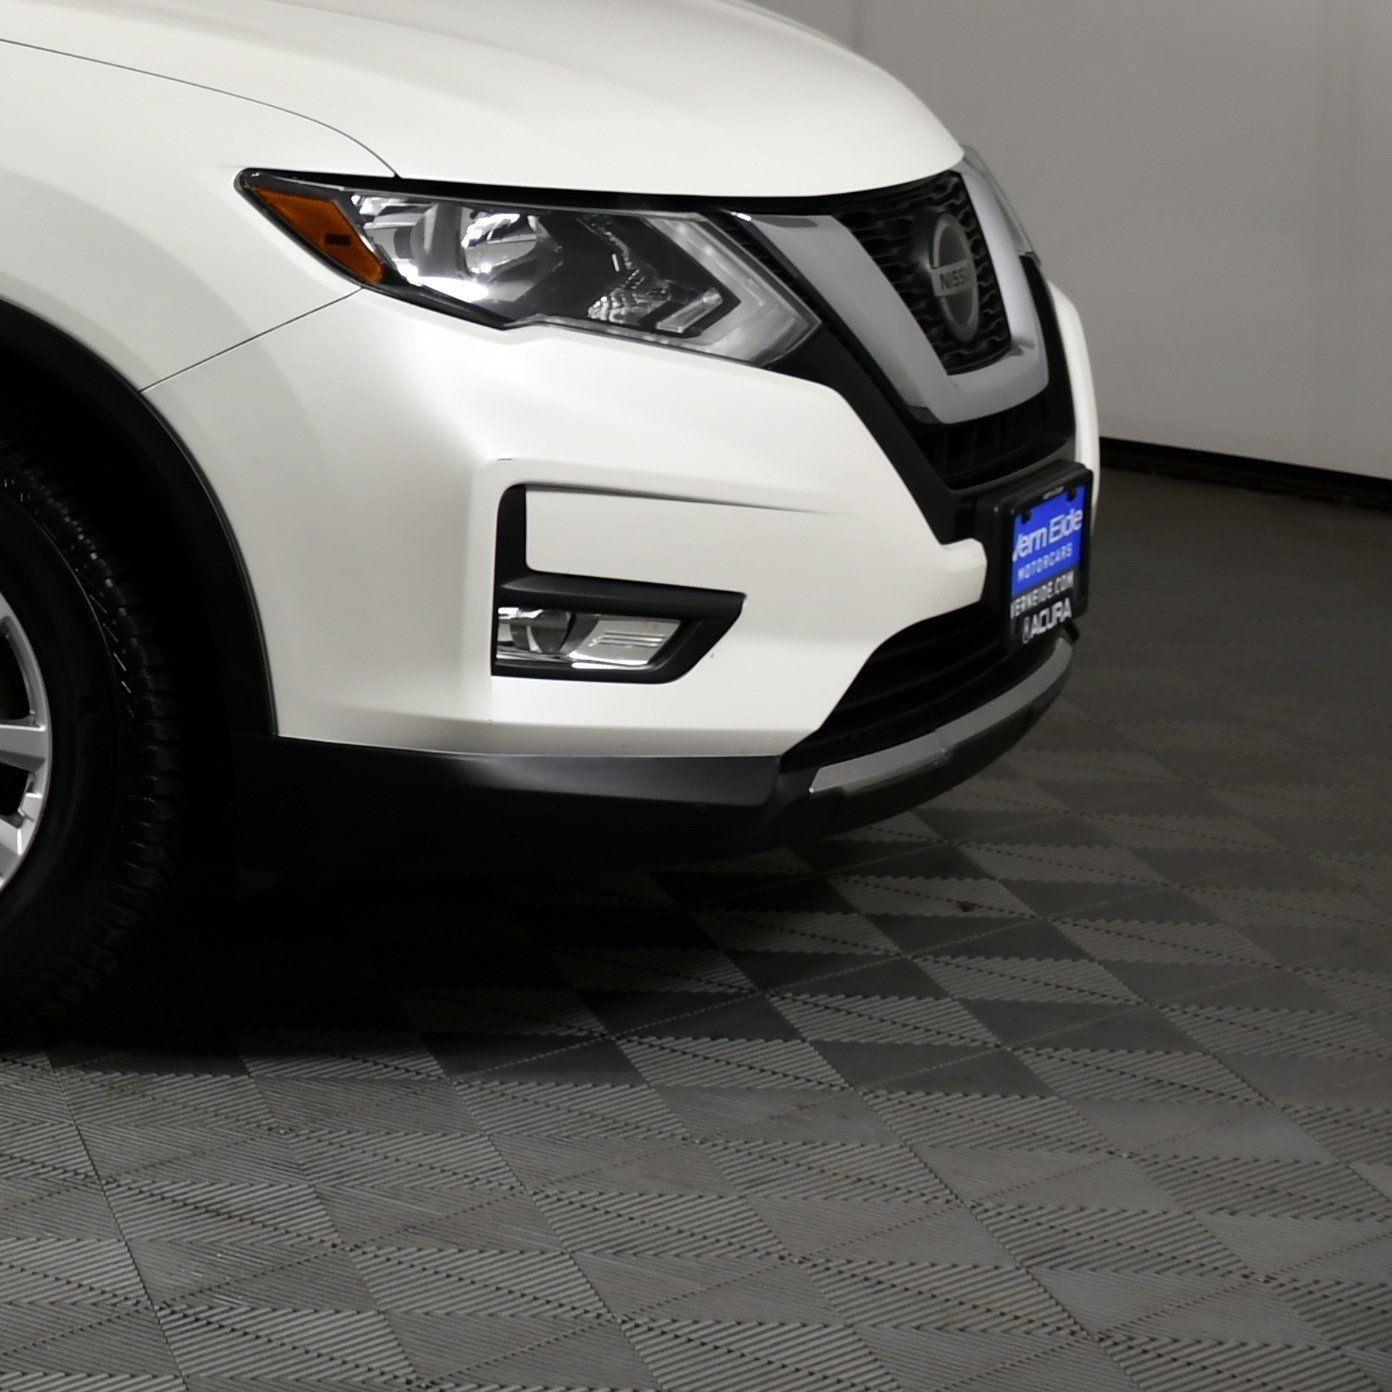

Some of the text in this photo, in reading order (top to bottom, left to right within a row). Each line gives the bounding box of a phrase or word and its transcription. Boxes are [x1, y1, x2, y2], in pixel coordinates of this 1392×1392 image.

[1048, 508, 1084, 544] Eide
[1017, 542, 1074, 582] MOTORCARS
[1030, 597, 1073, 639] ACURA
